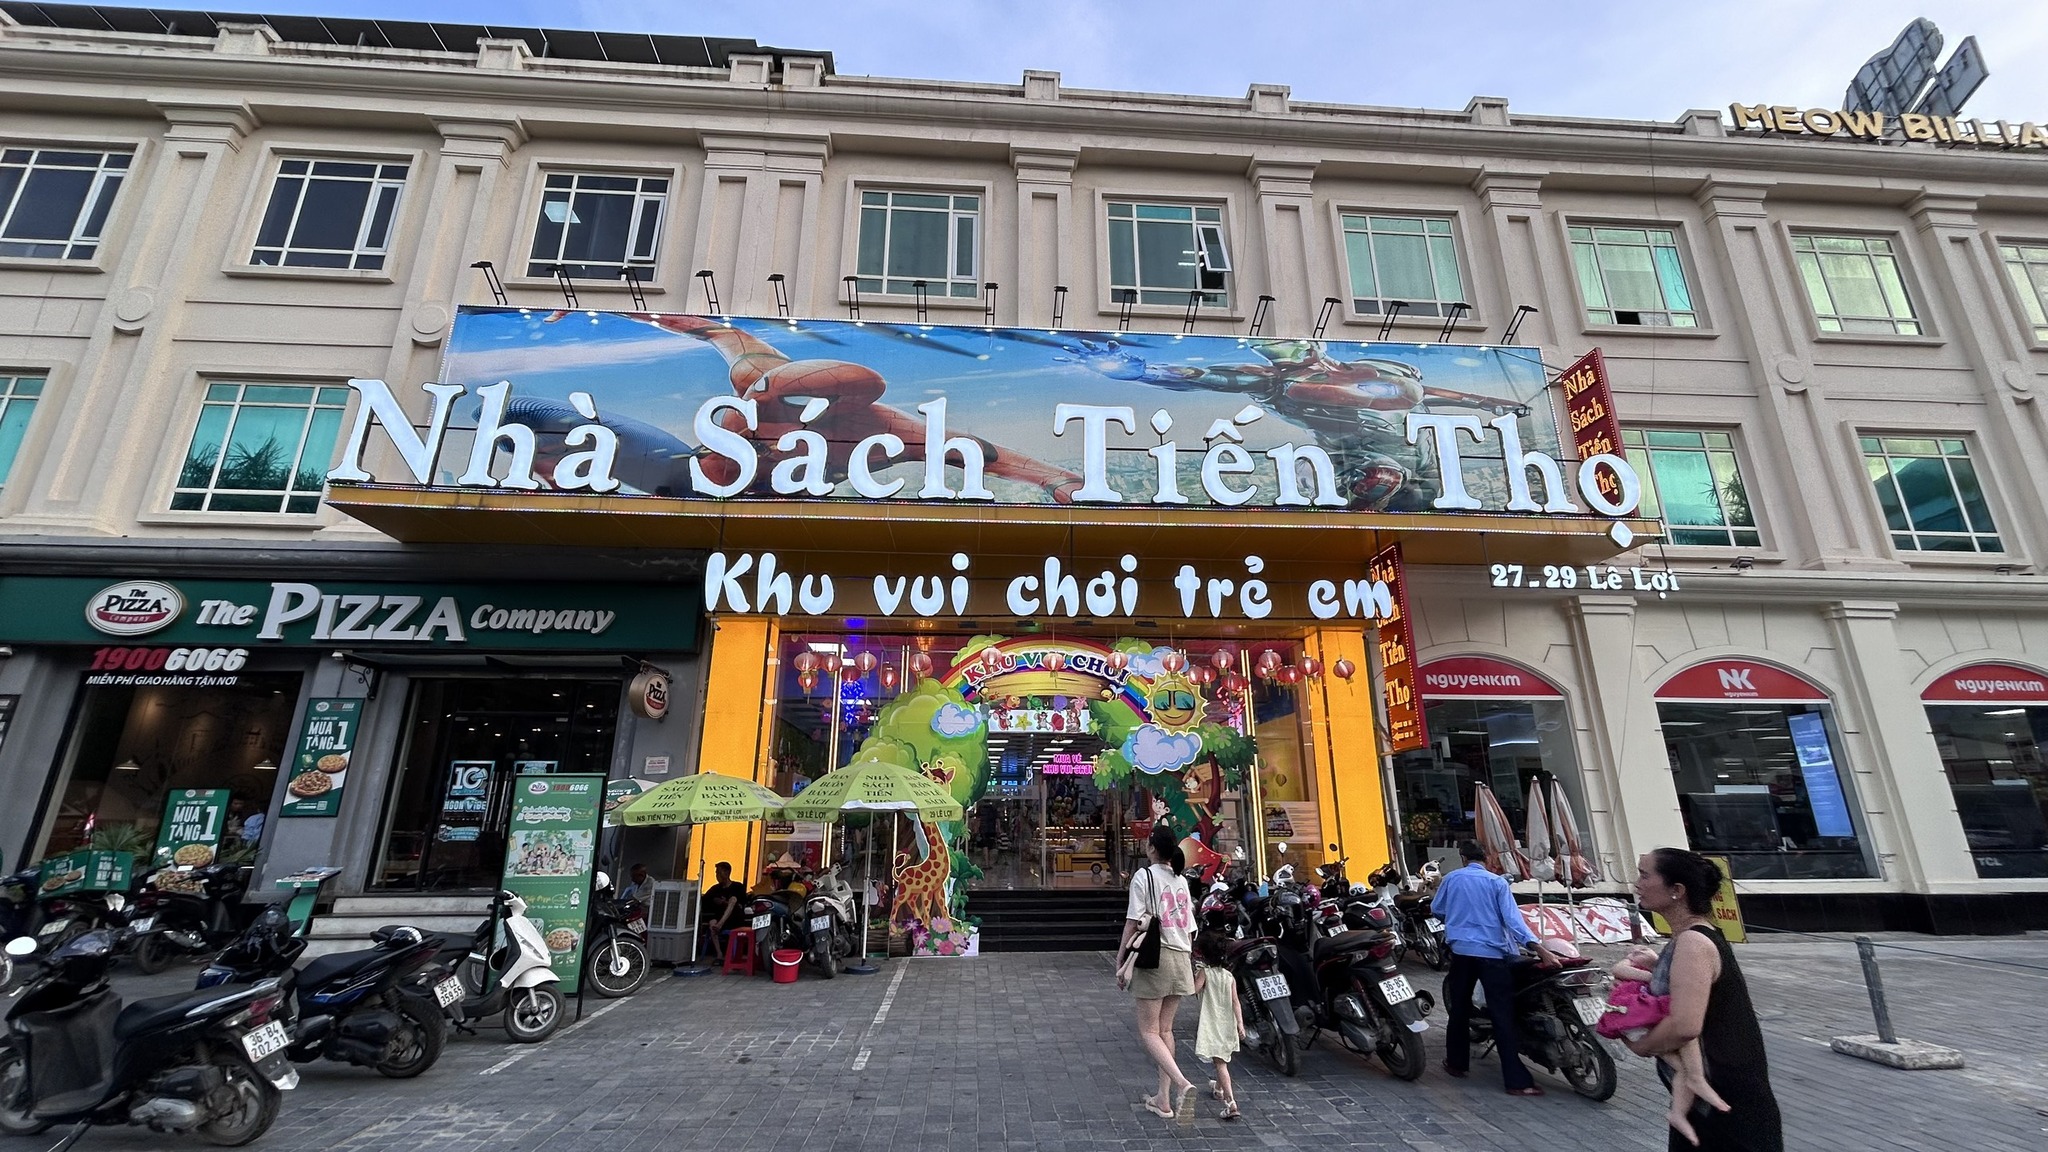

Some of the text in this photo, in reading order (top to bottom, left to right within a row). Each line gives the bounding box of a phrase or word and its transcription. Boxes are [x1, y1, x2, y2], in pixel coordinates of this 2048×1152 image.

[1729, 102, 1884, 139] MEOW
[1564, 364, 1597, 401] Nhà
[1570, 397, 1605, 433] Sách
[1578, 431, 1613, 462] Tiến
[327, 378, 1641, 548] Nhà Sách Tiến Thọ
[1594, 470, 1619, 496] họ
[129, 589, 148, 597] The
[705, 552, 1393, 619] Khu vui chơi trẻ em
[1585, 566, 1622, 590] Lê
[1630, 567, 1680, 599] Lợi
[103, 595, 162, 612] PIZZA
[196, 582, 616, 641] The PIZZA Company
[1379, 633, 1406, 668] Tiến
[86, 673, 237, 687] MIỄN PHÍ GIAO HÀNG TẬN NƠI
[1717, 668, 1756, 690] NK
[1385, 677, 1410, 711] Thọ
[308, 721, 333, 735] MUA
[333, 721, 349, 750] 1
[305, 735, 334, 752] TẶNG
[173, 805, 200, 823] MUA
[200, 805, 218, 841] 1
[796, 810, 804, 818] 29
[169, 822, 201, 844] TẶNG
[1976, 857, 2003, 866] TCL
[1260, 975, 1283, 988] 36-B2
[1262, 985, 1289, 999] 689.95
[1382, 976, 1405, 994] 36-B5
[1386, 986, 1412, 1005] 253.11
[248, 1020, 280, 1047] 36-B4
[250, 1034, 288, 1060] 202.31
